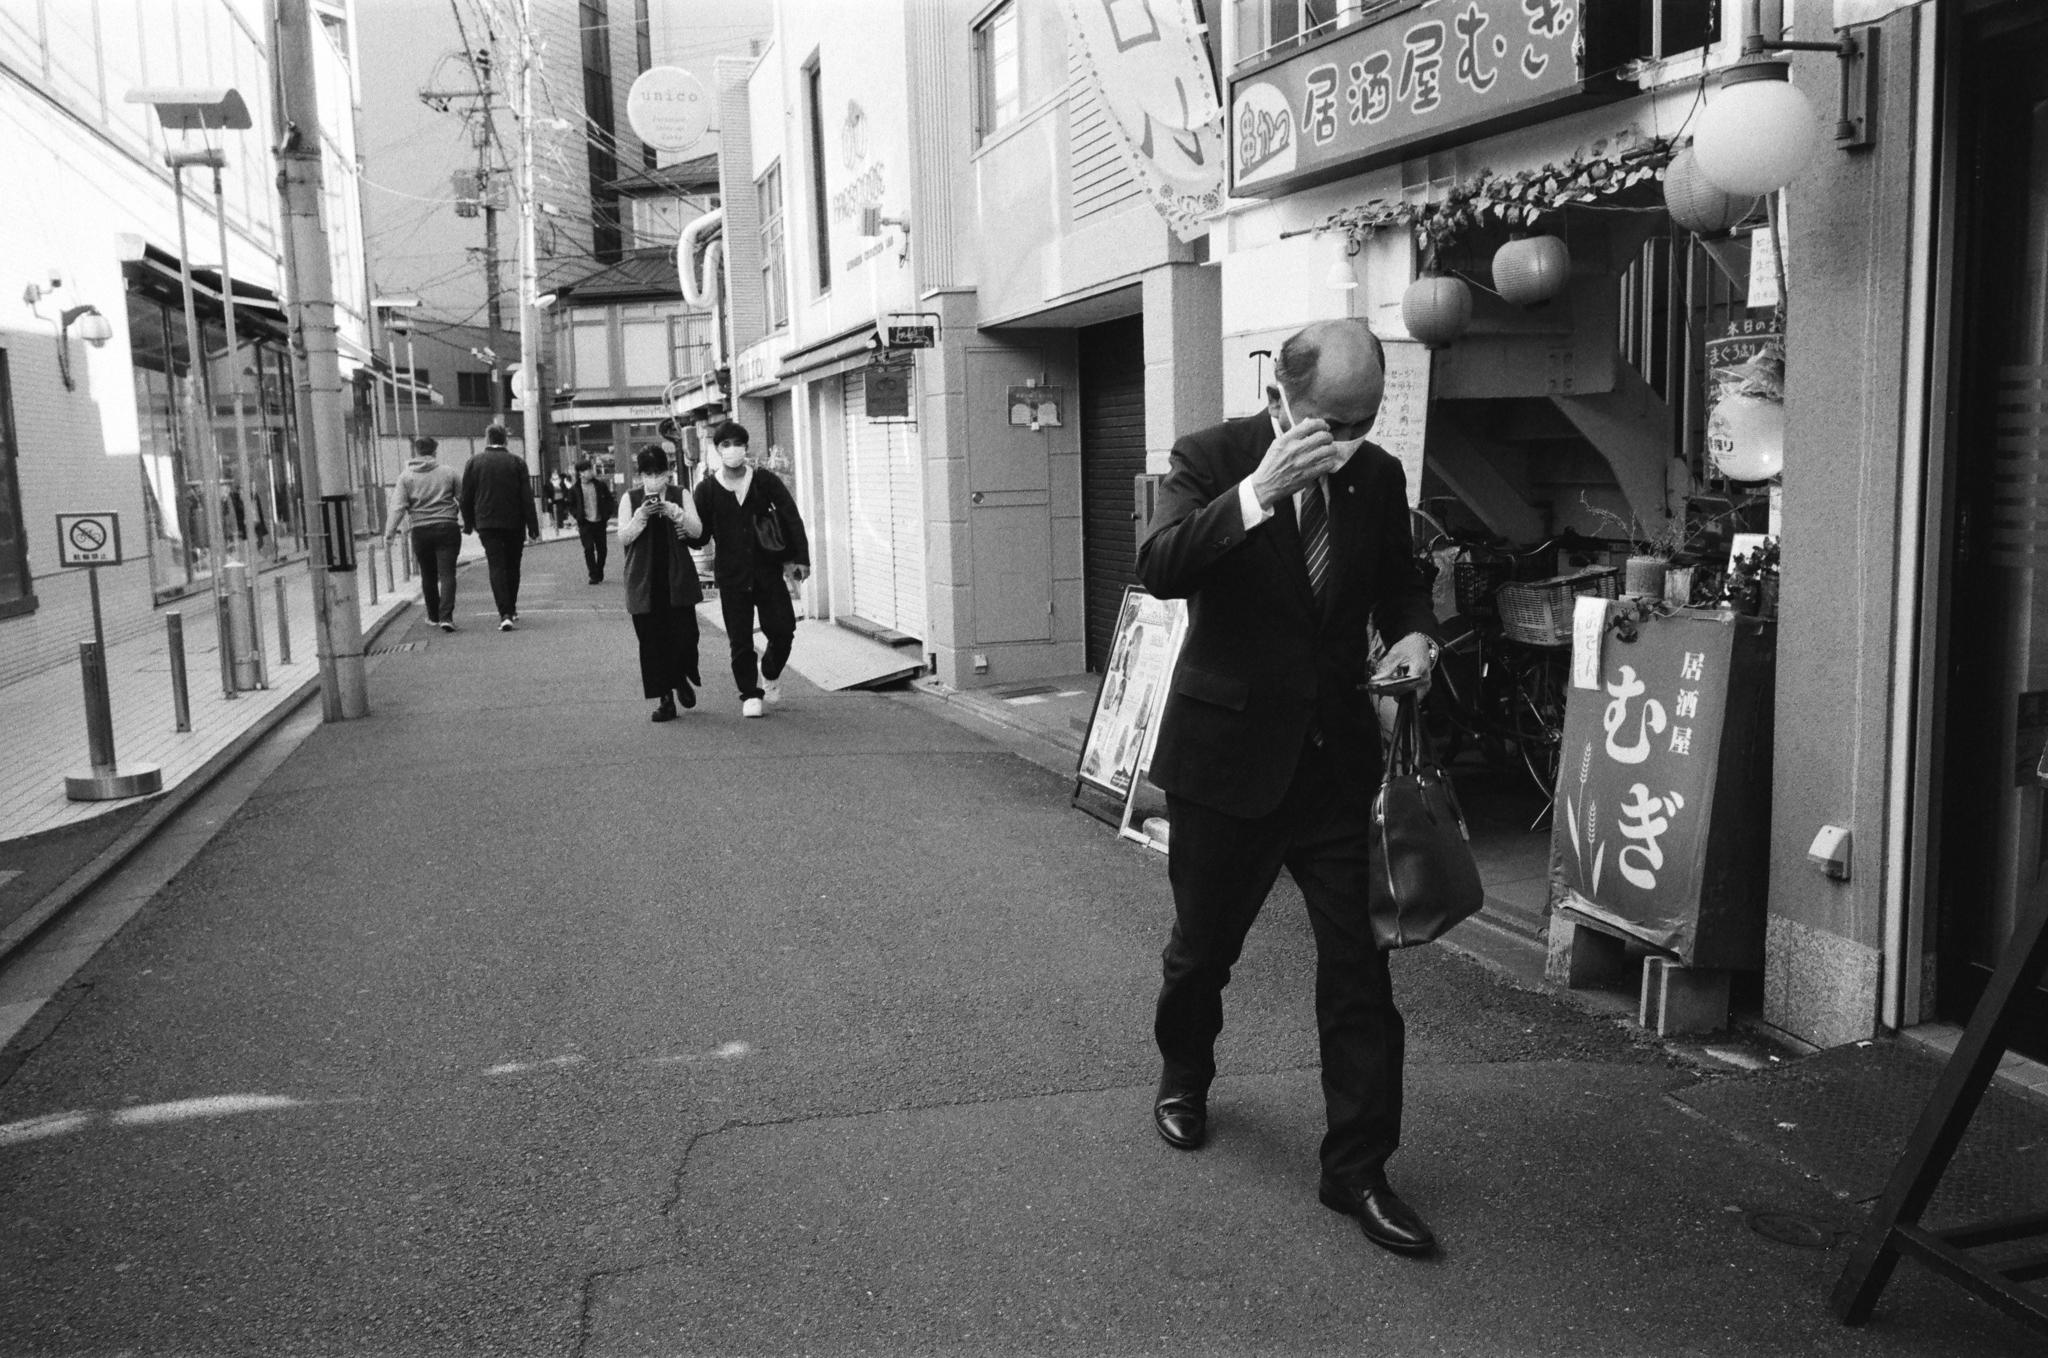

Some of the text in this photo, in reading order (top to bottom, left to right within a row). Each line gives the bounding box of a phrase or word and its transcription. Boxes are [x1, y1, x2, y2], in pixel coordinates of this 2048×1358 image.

[641, 89, 698, 102] unico
[1240, 101, 1290, 168] 串かつ
[1667, 651, 1705, 756] 居酒屋
[1603, 664, 1685, 890] むぎ
